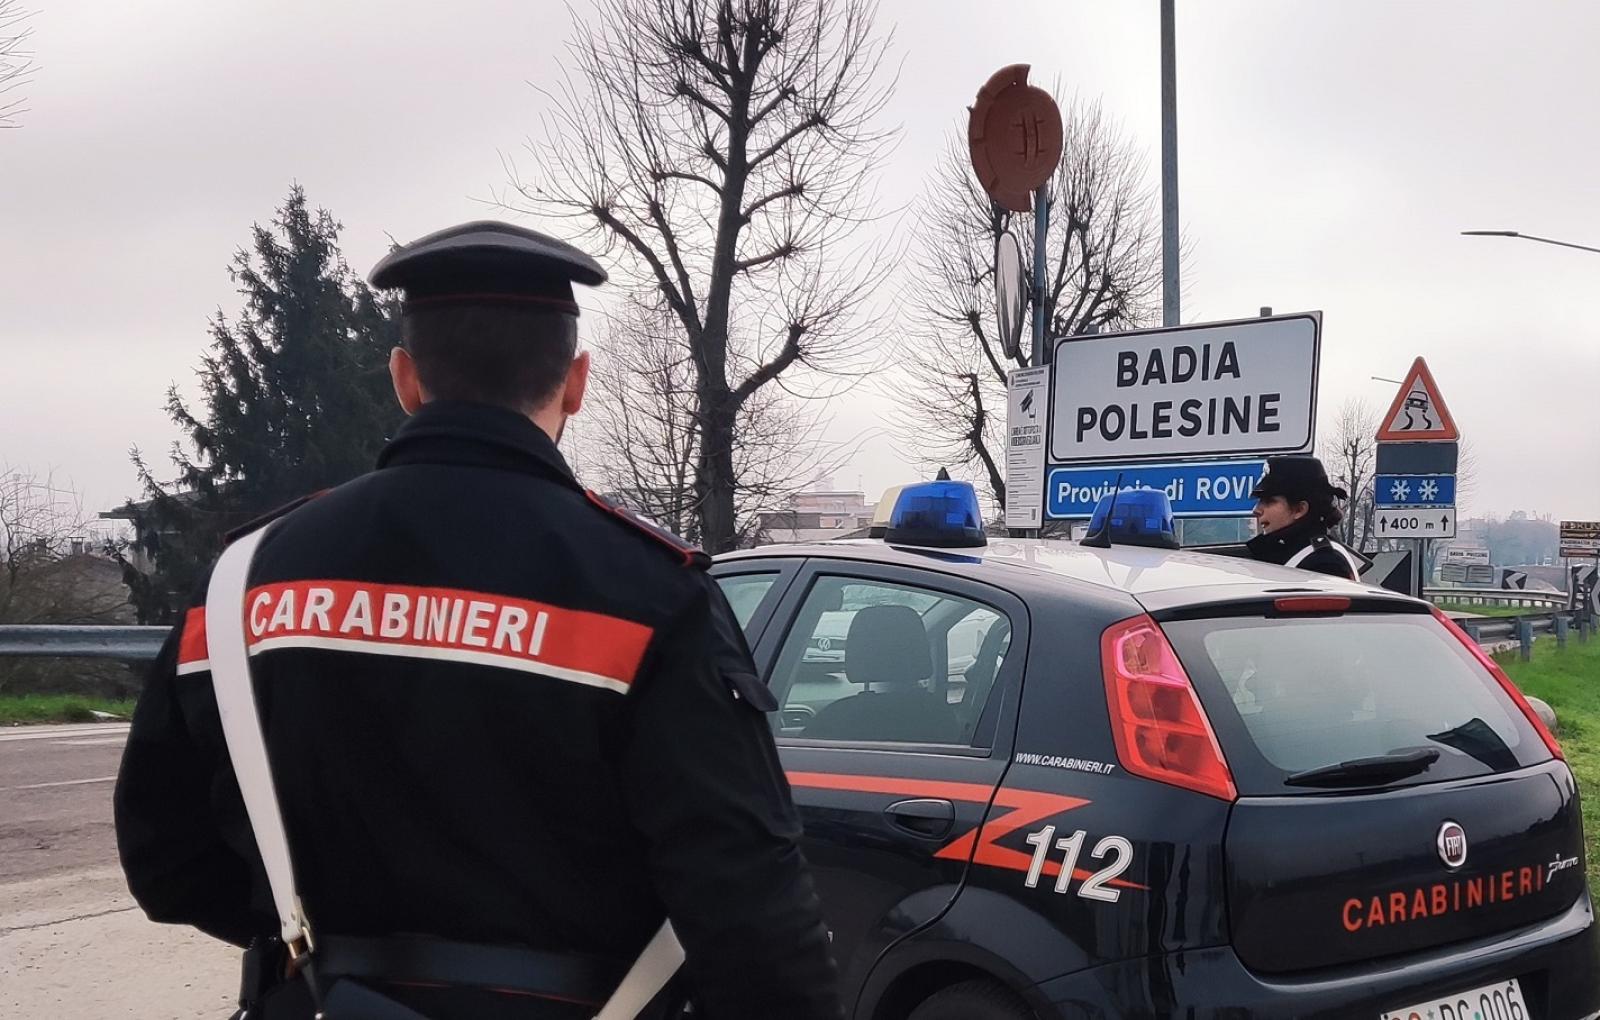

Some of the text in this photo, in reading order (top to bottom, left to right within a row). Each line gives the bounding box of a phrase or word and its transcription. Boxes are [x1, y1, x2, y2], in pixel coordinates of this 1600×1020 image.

[1116, 341, 1241, 388] BADIA
[1076, 392, 1281, 443] POLESINE
[1057, 475, 1262, 504] Provi di ROVI
[1389, 517, 1435, 530] 400 m
[249, 587, 548, 656] CARABINIERI
[1015, 752, 1115, 775] WWW.CARABINIERI.IT
[1025, 825, 1134, 903] 112
[1342, 864, 1543, 932] CARABINIERI
